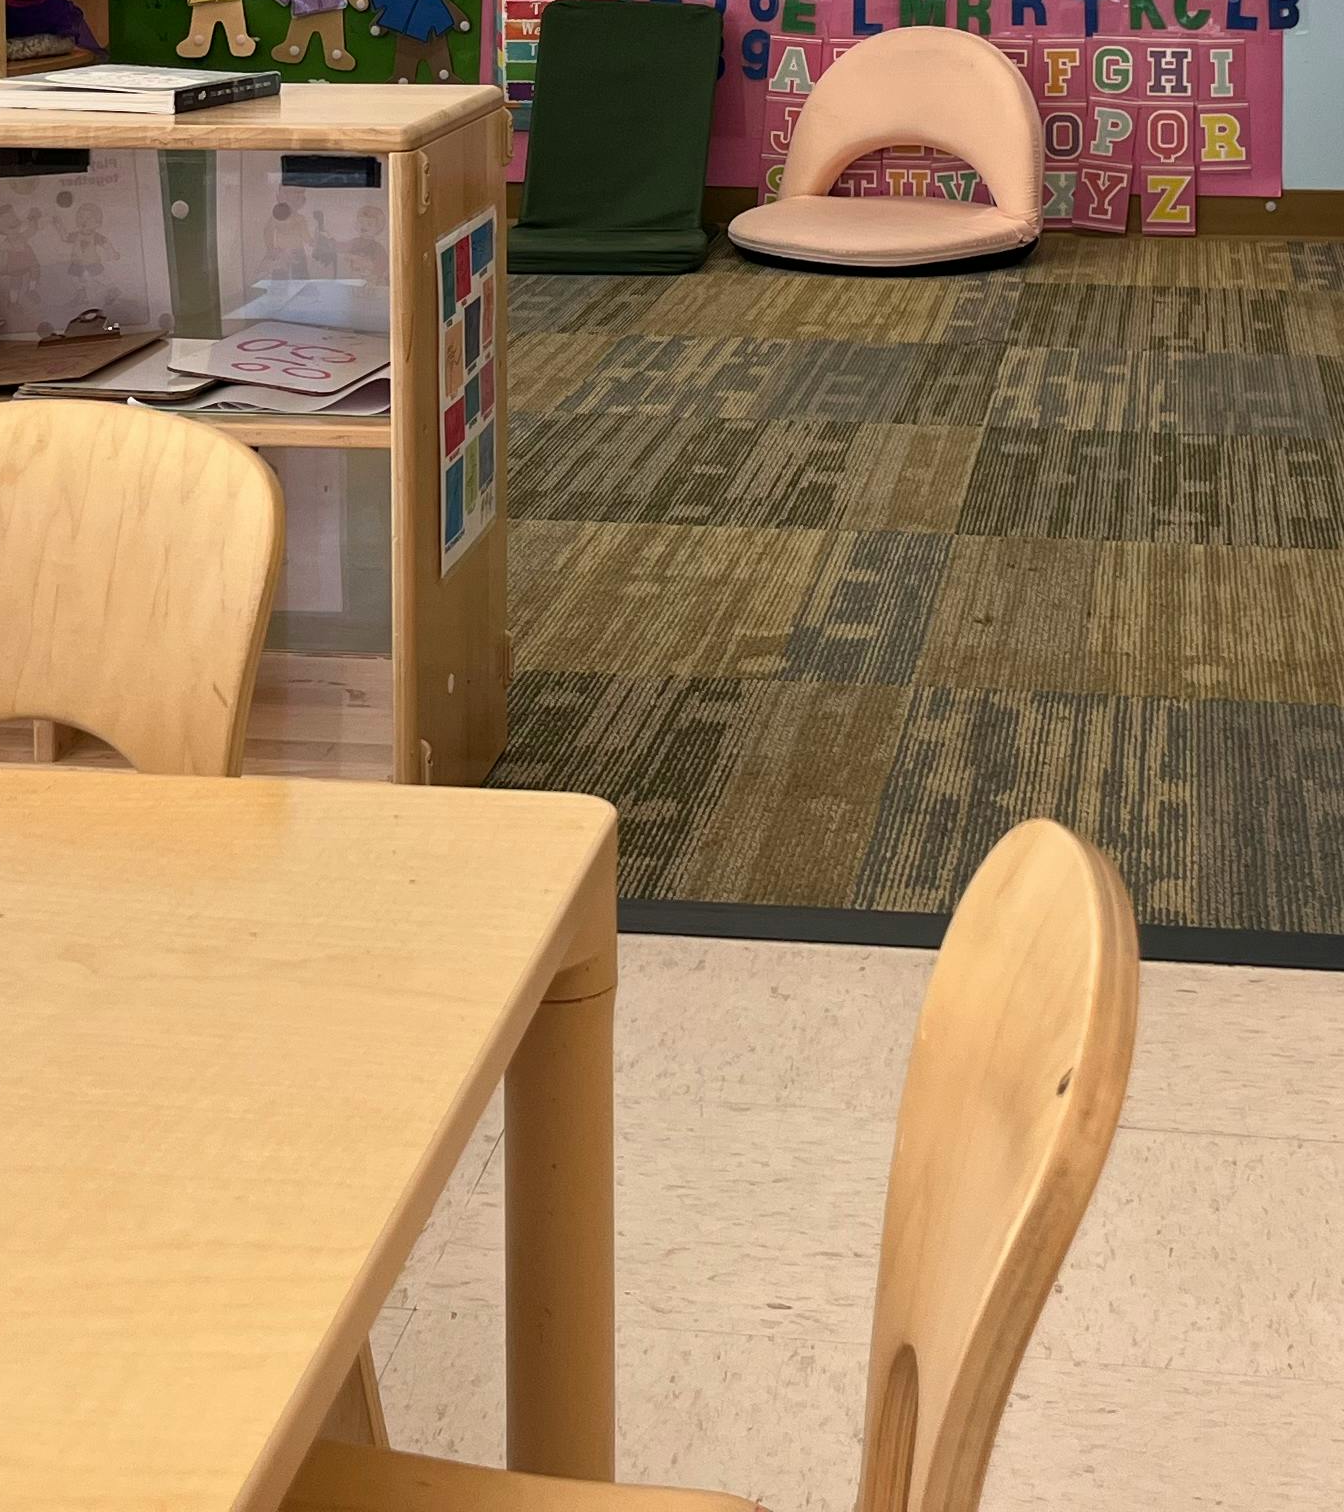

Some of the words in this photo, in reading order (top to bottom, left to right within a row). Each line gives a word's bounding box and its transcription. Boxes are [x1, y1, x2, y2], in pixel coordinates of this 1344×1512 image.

[741, 28, 769, 81] 9
[769, 46, 815, 94] A
[1044, 48, 1080, 96] F
[1093, 46, 1133, 94] G
[1147, 48, 1192, 96] H
[1210, 49, 1234, 97] I
[1044, 112, 1083, 159] O
[1089, 106, 1133, 156] P
[1147, 109, 1188, 162] Q
[1200, 113, 1246, 161] R
[1082, 168, 1128, 219] Y
[1146, 175, 1192, 223] Z
